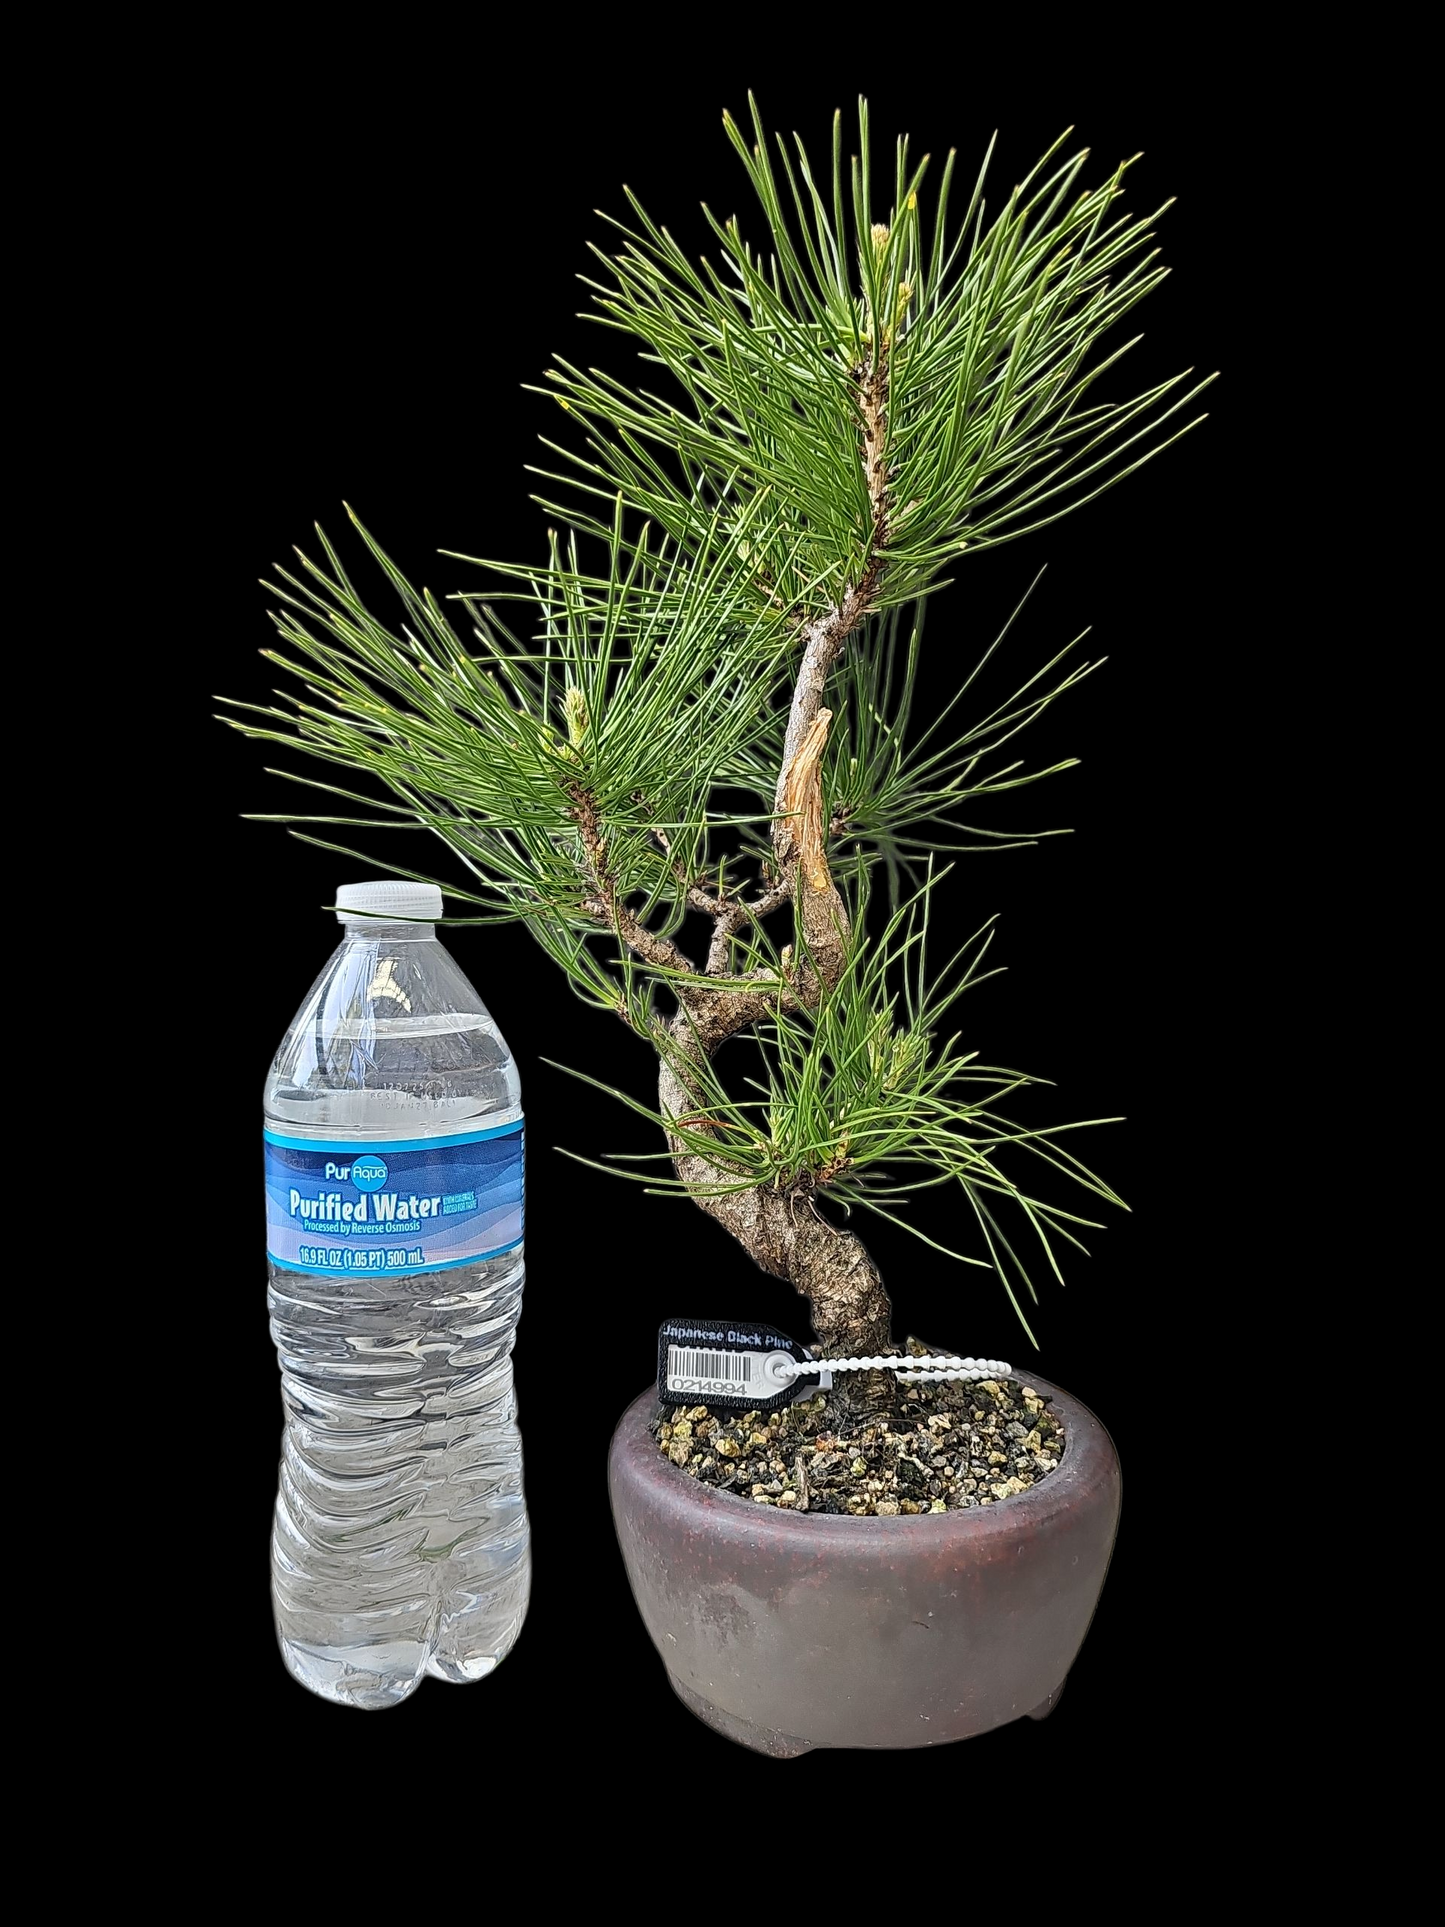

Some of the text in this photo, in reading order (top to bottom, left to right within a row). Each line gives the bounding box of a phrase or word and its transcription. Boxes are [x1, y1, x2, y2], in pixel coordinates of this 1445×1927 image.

[289, 1188, 441, 1222] Purified Water
[304, 1220, 421, 1236] Processed by Reverse Osmosis
[300, 1247, 424, 1270] 16.9 FL OZ (1.05 PT) 500 mL
[663, 1325, 794, 1350] Japanese Black Pine
[671, 1378, 748, 1396] 0214994
